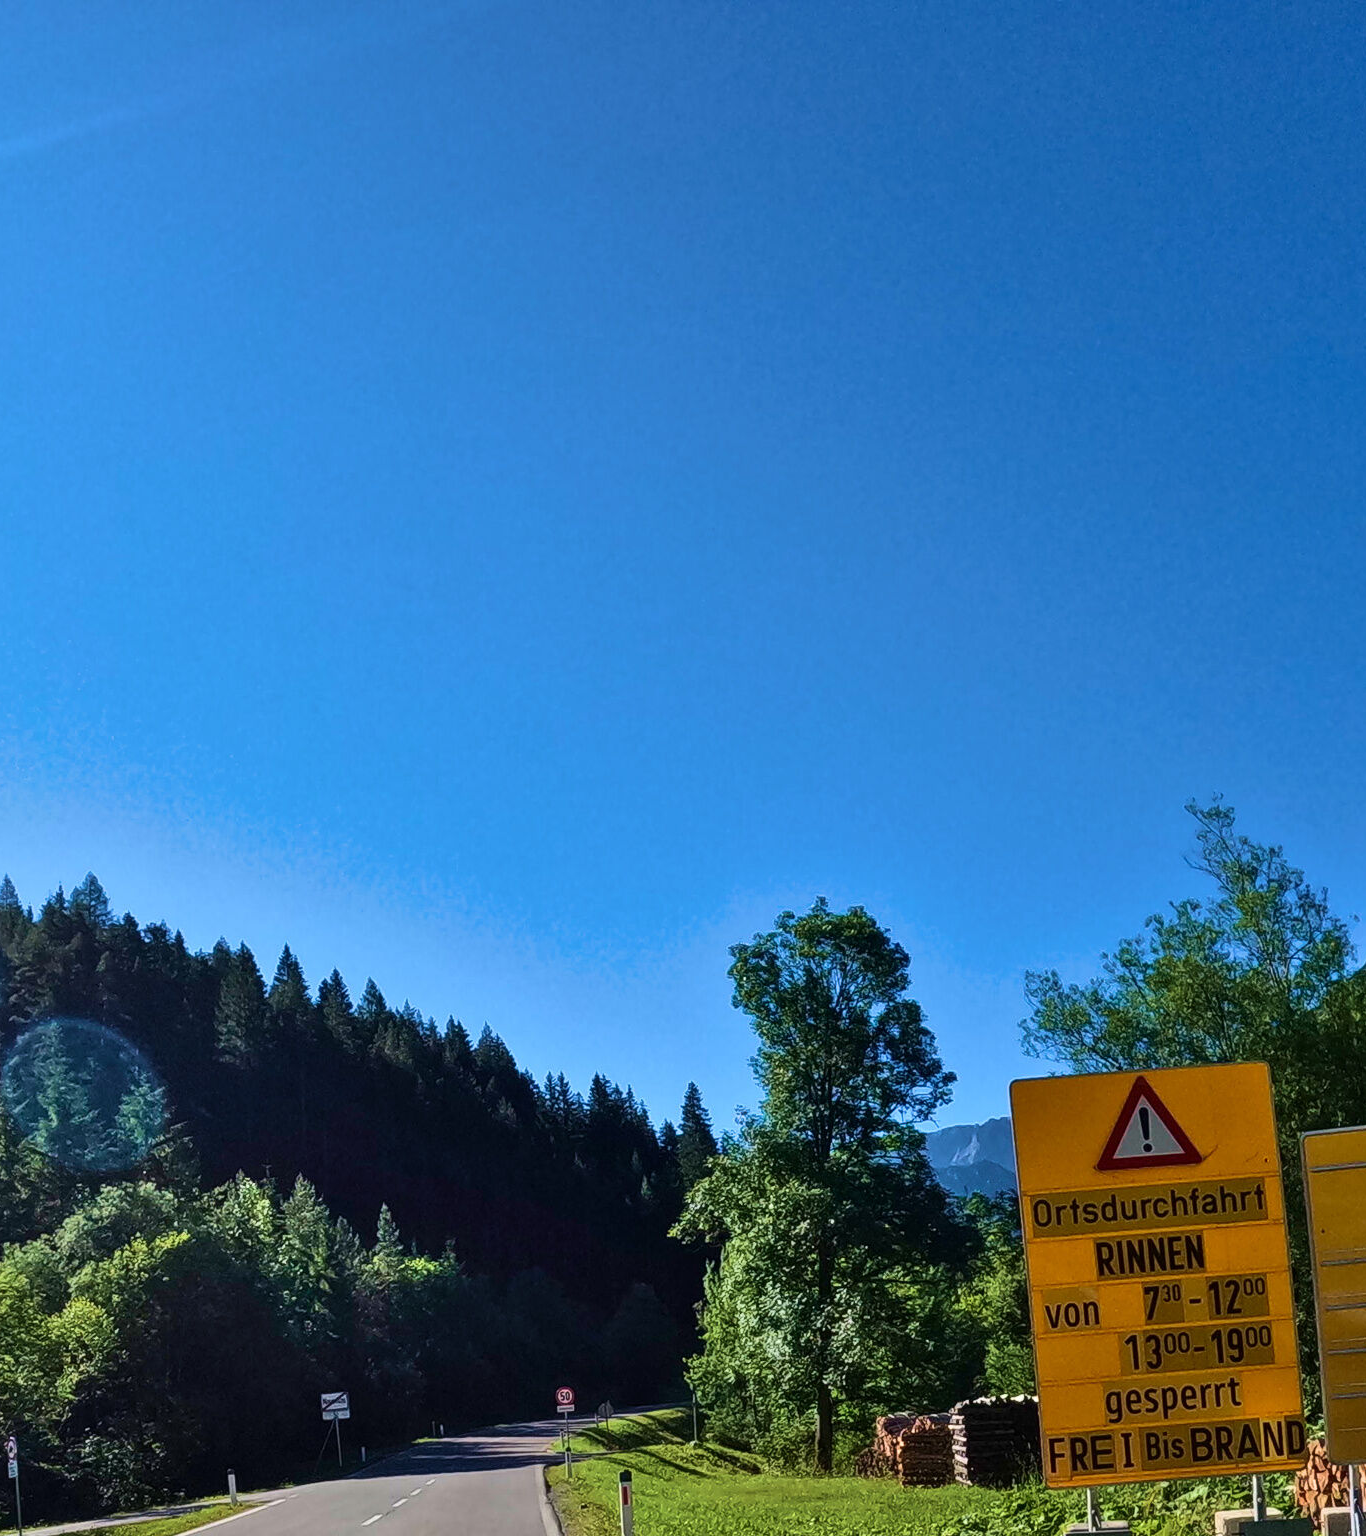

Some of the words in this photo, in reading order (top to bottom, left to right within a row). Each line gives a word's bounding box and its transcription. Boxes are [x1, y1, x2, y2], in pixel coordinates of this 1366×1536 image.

[1034, 1184, 1264, 1227] Ortsdurchfahrt
[1096, 1234, 1205, 1277] RINNEN
[1045, 1301, 1100, 1329] von
[560, 1391, 571, 1401] 50
[1105, 1377, 1242, 1424] gesperrt
[1146, 1432, 1184, 1461] Bis
[1190, 1420, 1305, 1462] BRAND
